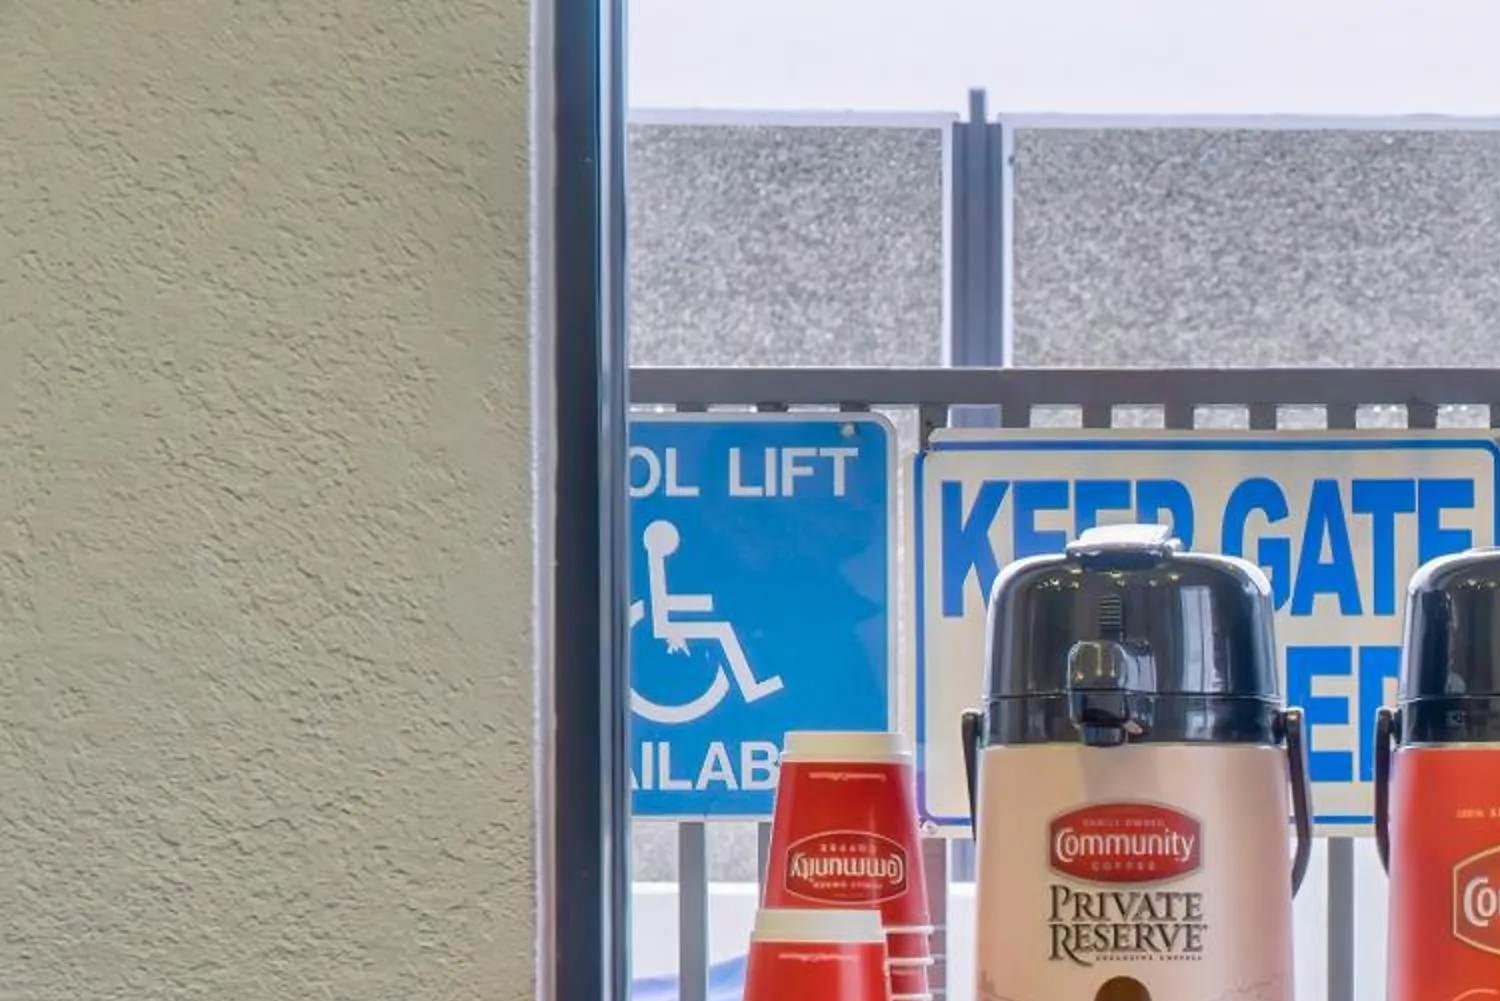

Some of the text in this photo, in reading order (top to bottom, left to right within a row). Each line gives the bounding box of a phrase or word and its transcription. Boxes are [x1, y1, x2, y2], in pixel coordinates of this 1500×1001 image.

[729, 447, 859, 497] LIFT
[1056, 827, 1195, 863] Community
[790, 852, 905, 886] Community
[1048, 884, 1203, 922] PRIVATE
[1048, 923, 1204, 967] RESERVE
